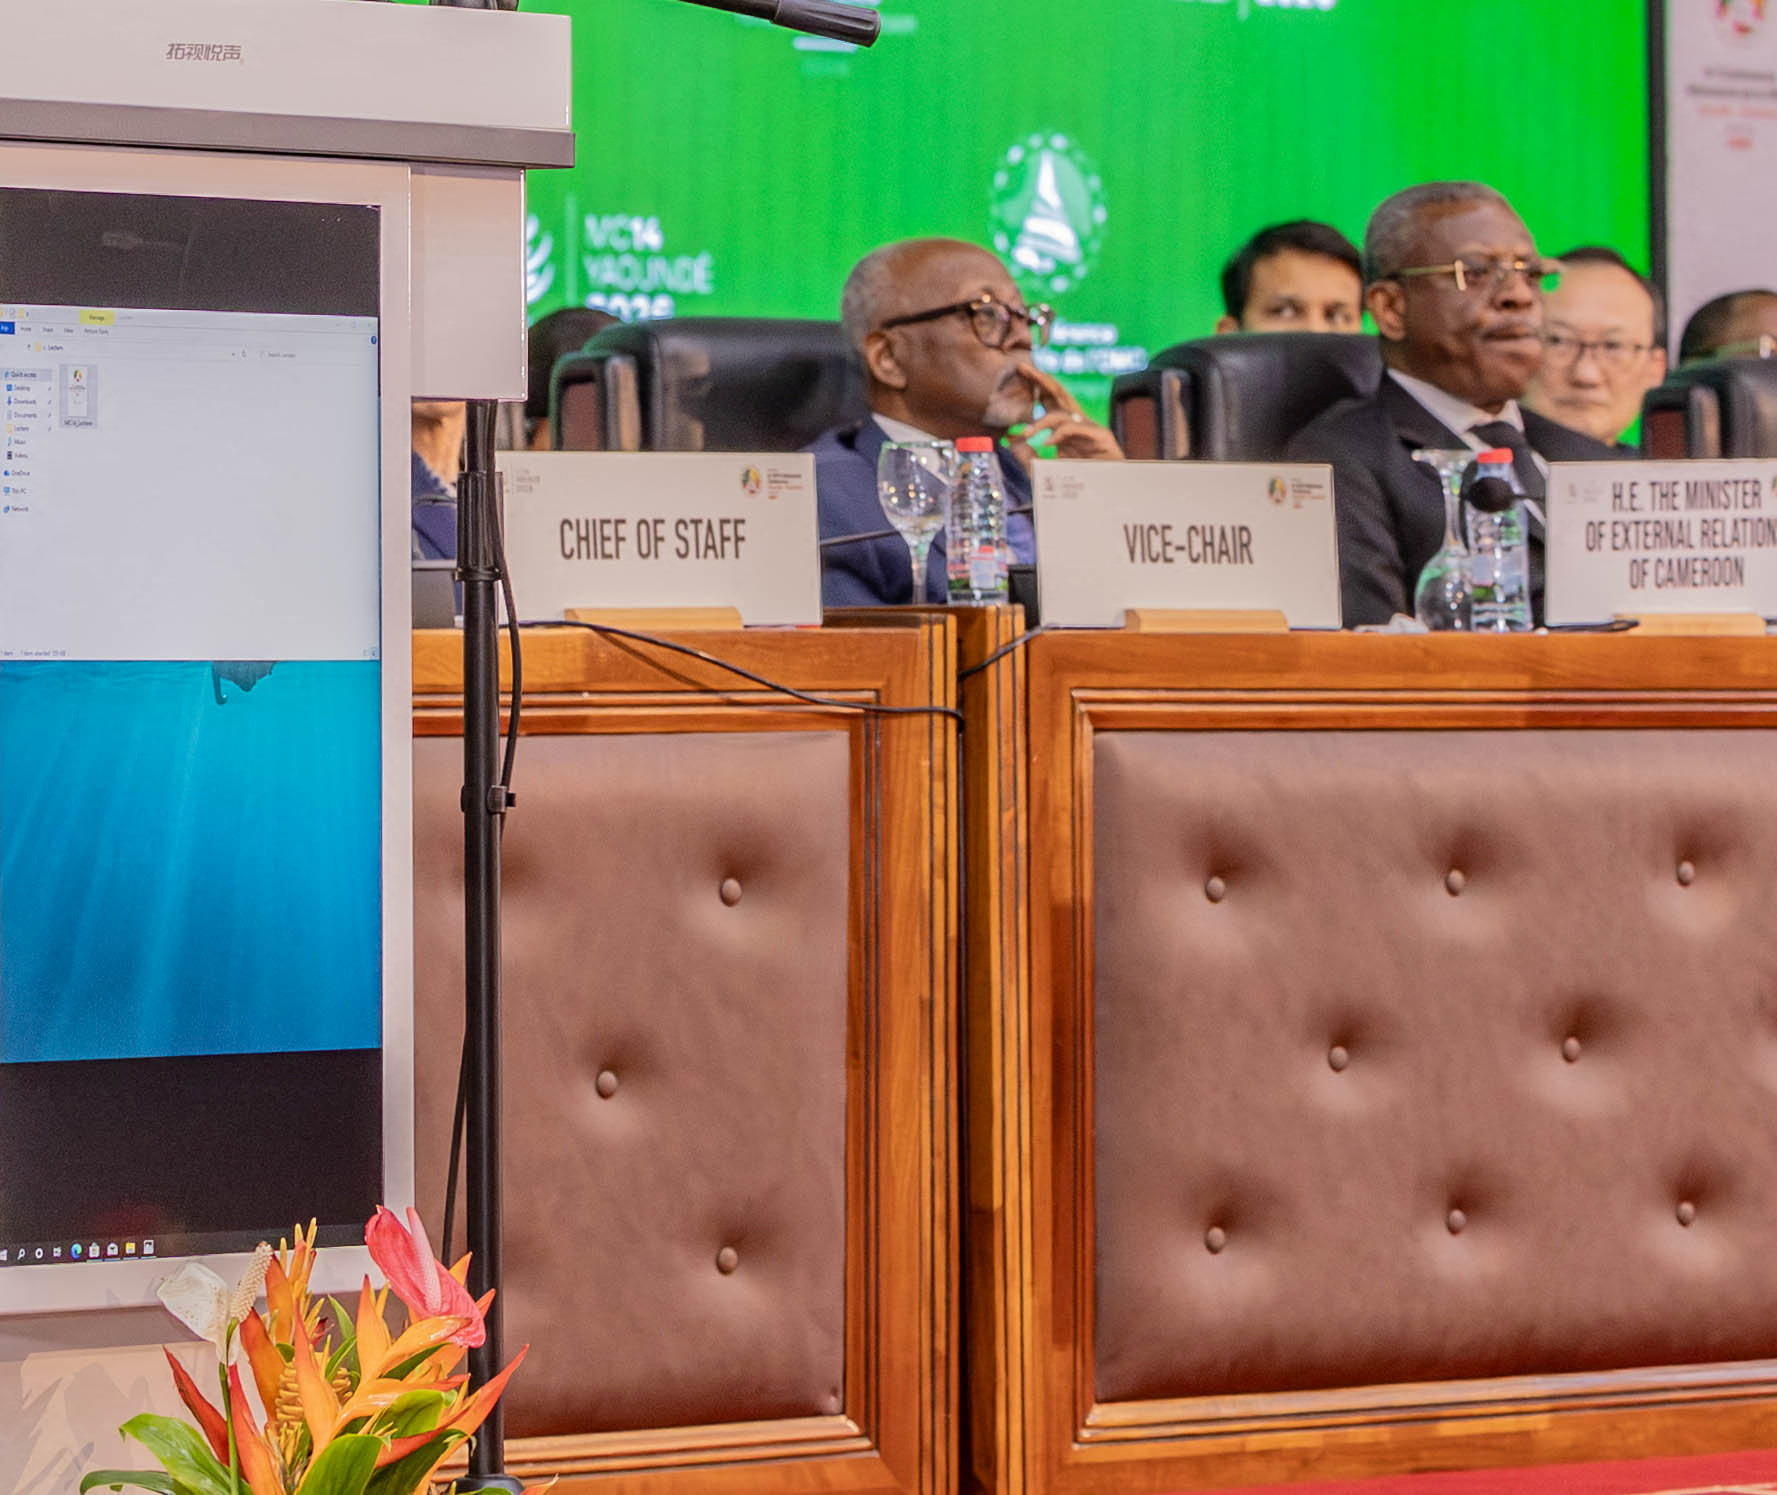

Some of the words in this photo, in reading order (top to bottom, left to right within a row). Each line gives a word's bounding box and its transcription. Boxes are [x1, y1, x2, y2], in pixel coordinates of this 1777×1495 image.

[1612, 480, 1644, 513] H.E.
[1649, 480, 1681, 512] THE
[1684, 479, 1763, 511] MINISTER
[559, 518, 627, 560] CHIEF
[636, 518, 666, 560] OF
[674, 518, 747, 561] STAFF
[1123, 523, 1255, 565] VICE-CHAIR
[1585, 520, 1607, 552] OF
[1611, 519, 1695, 552] EXTERNAL
[1628, 558, 1648, 591] OF
[1654, 557, 1745, 591] CAMEROON
